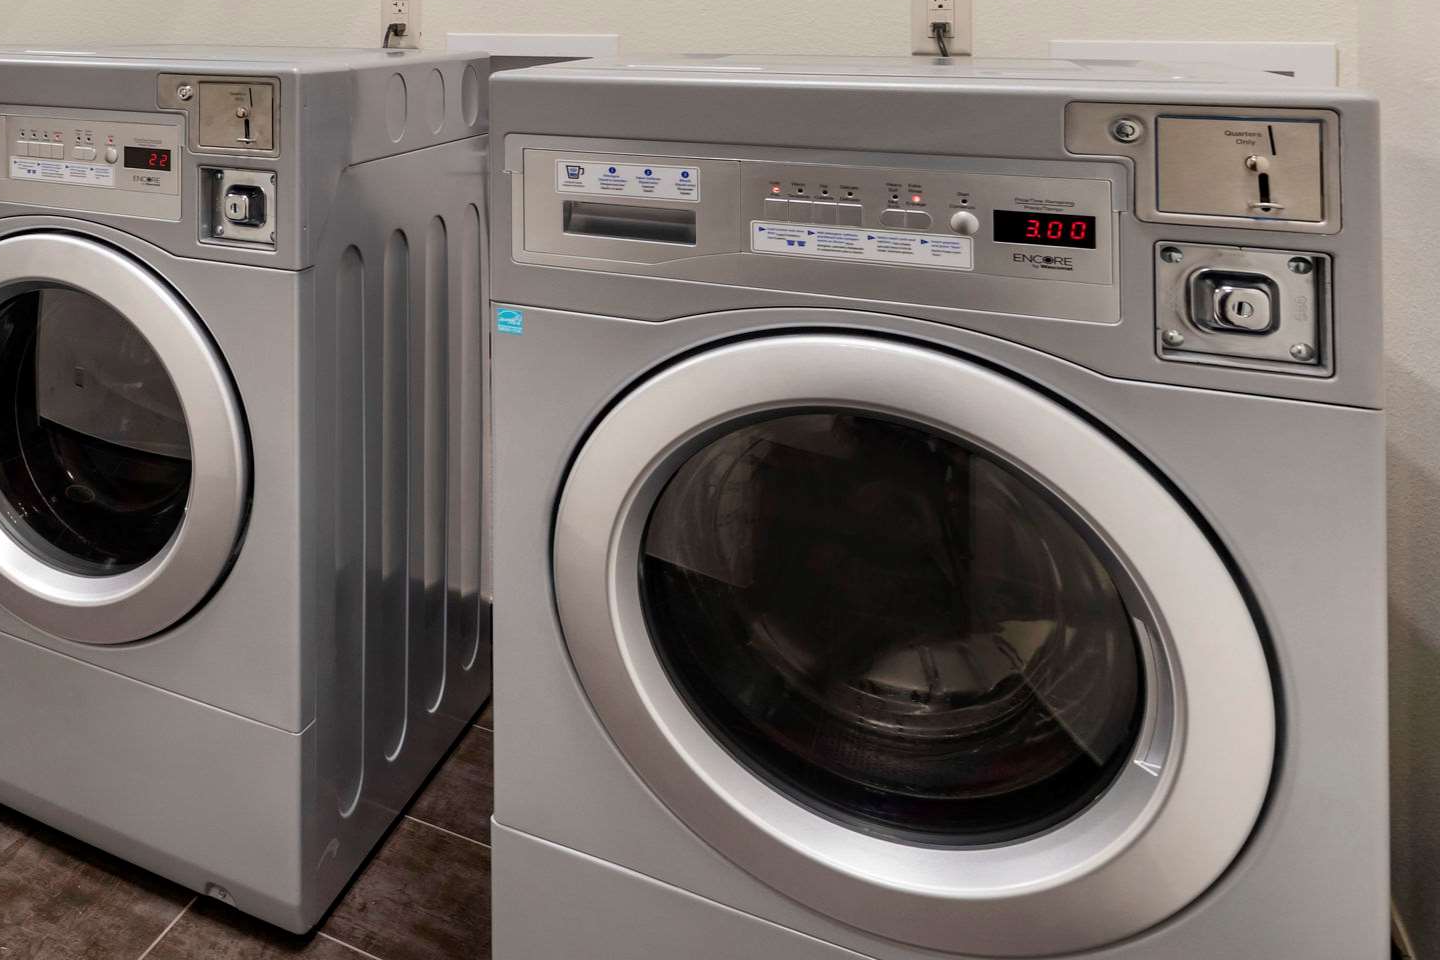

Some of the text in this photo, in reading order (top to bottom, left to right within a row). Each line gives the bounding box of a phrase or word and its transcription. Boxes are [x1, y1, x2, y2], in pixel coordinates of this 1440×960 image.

[1224, 130, 1263, 138] Quarters
[148, 152, 169, 168] 22
[1025, 219, 1087, 240] 3.00
[1012, 253, 1073, 266] ENCORE
